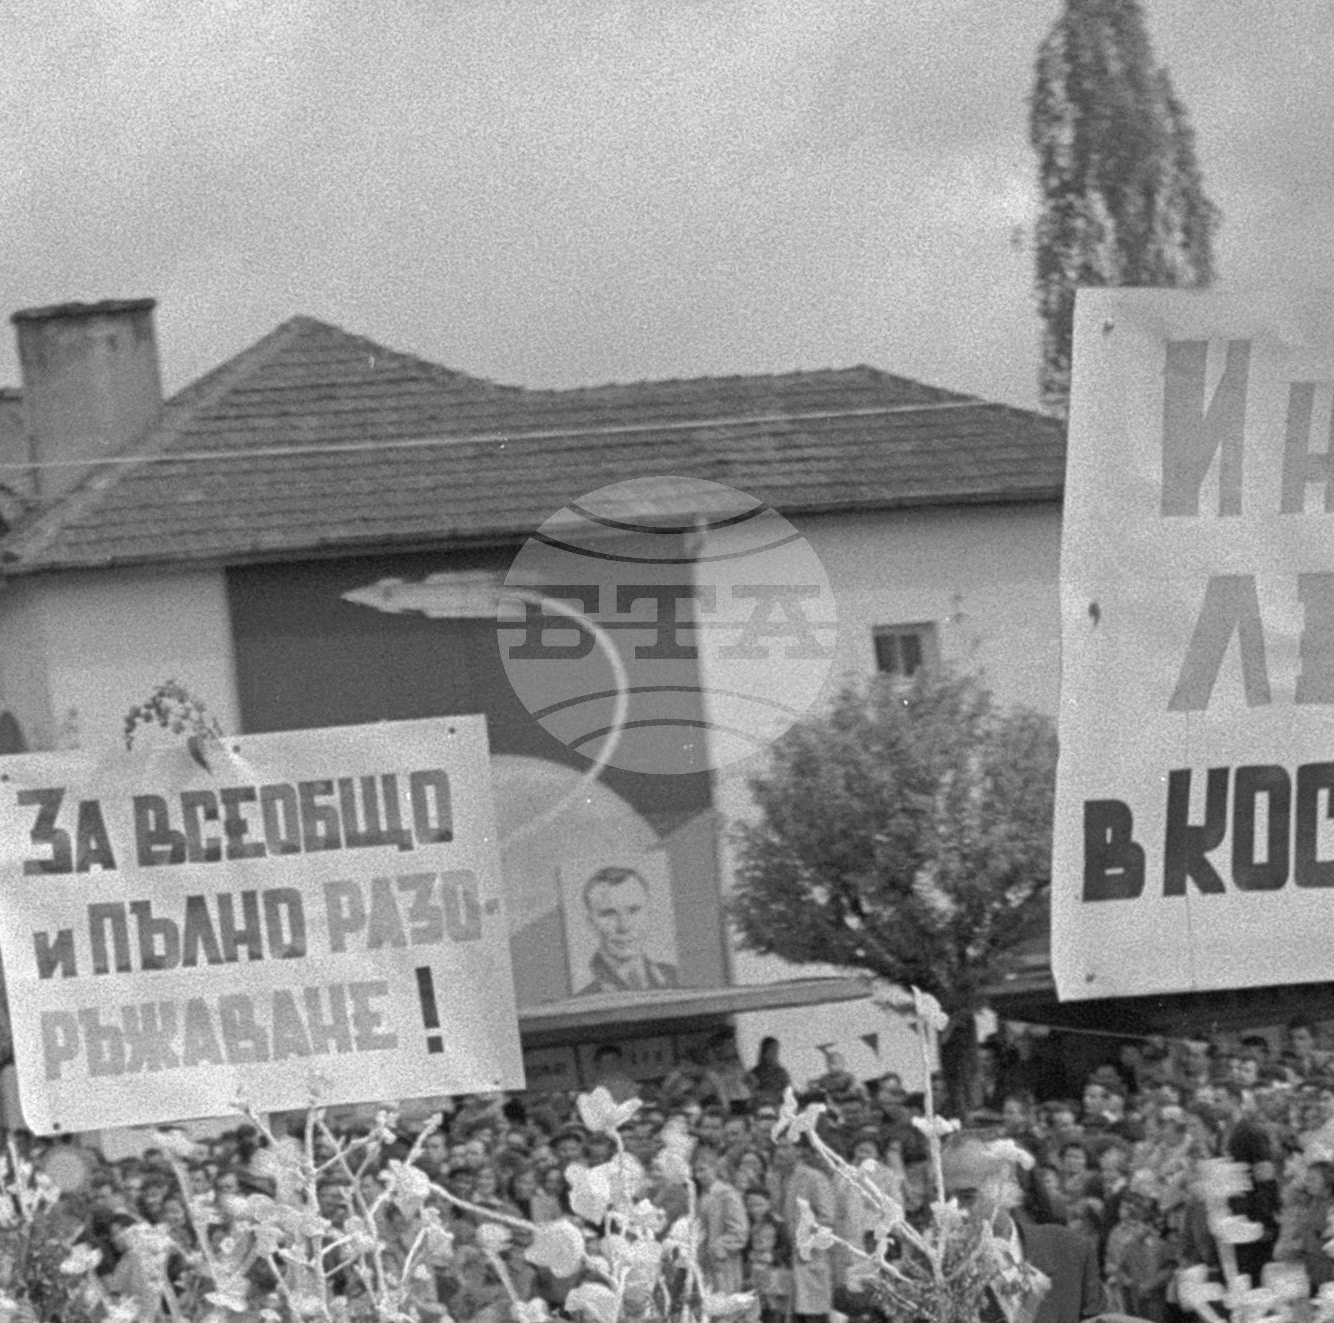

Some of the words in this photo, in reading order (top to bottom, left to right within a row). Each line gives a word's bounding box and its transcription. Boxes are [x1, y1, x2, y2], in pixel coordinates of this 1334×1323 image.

[1160, 339, 1253, 518] И
[17, 786, 118, 877] ЗА
[132, 768, 454, 868] ВСЕОБЩО
[86, 887, 307, 977] ПЪЛНО
